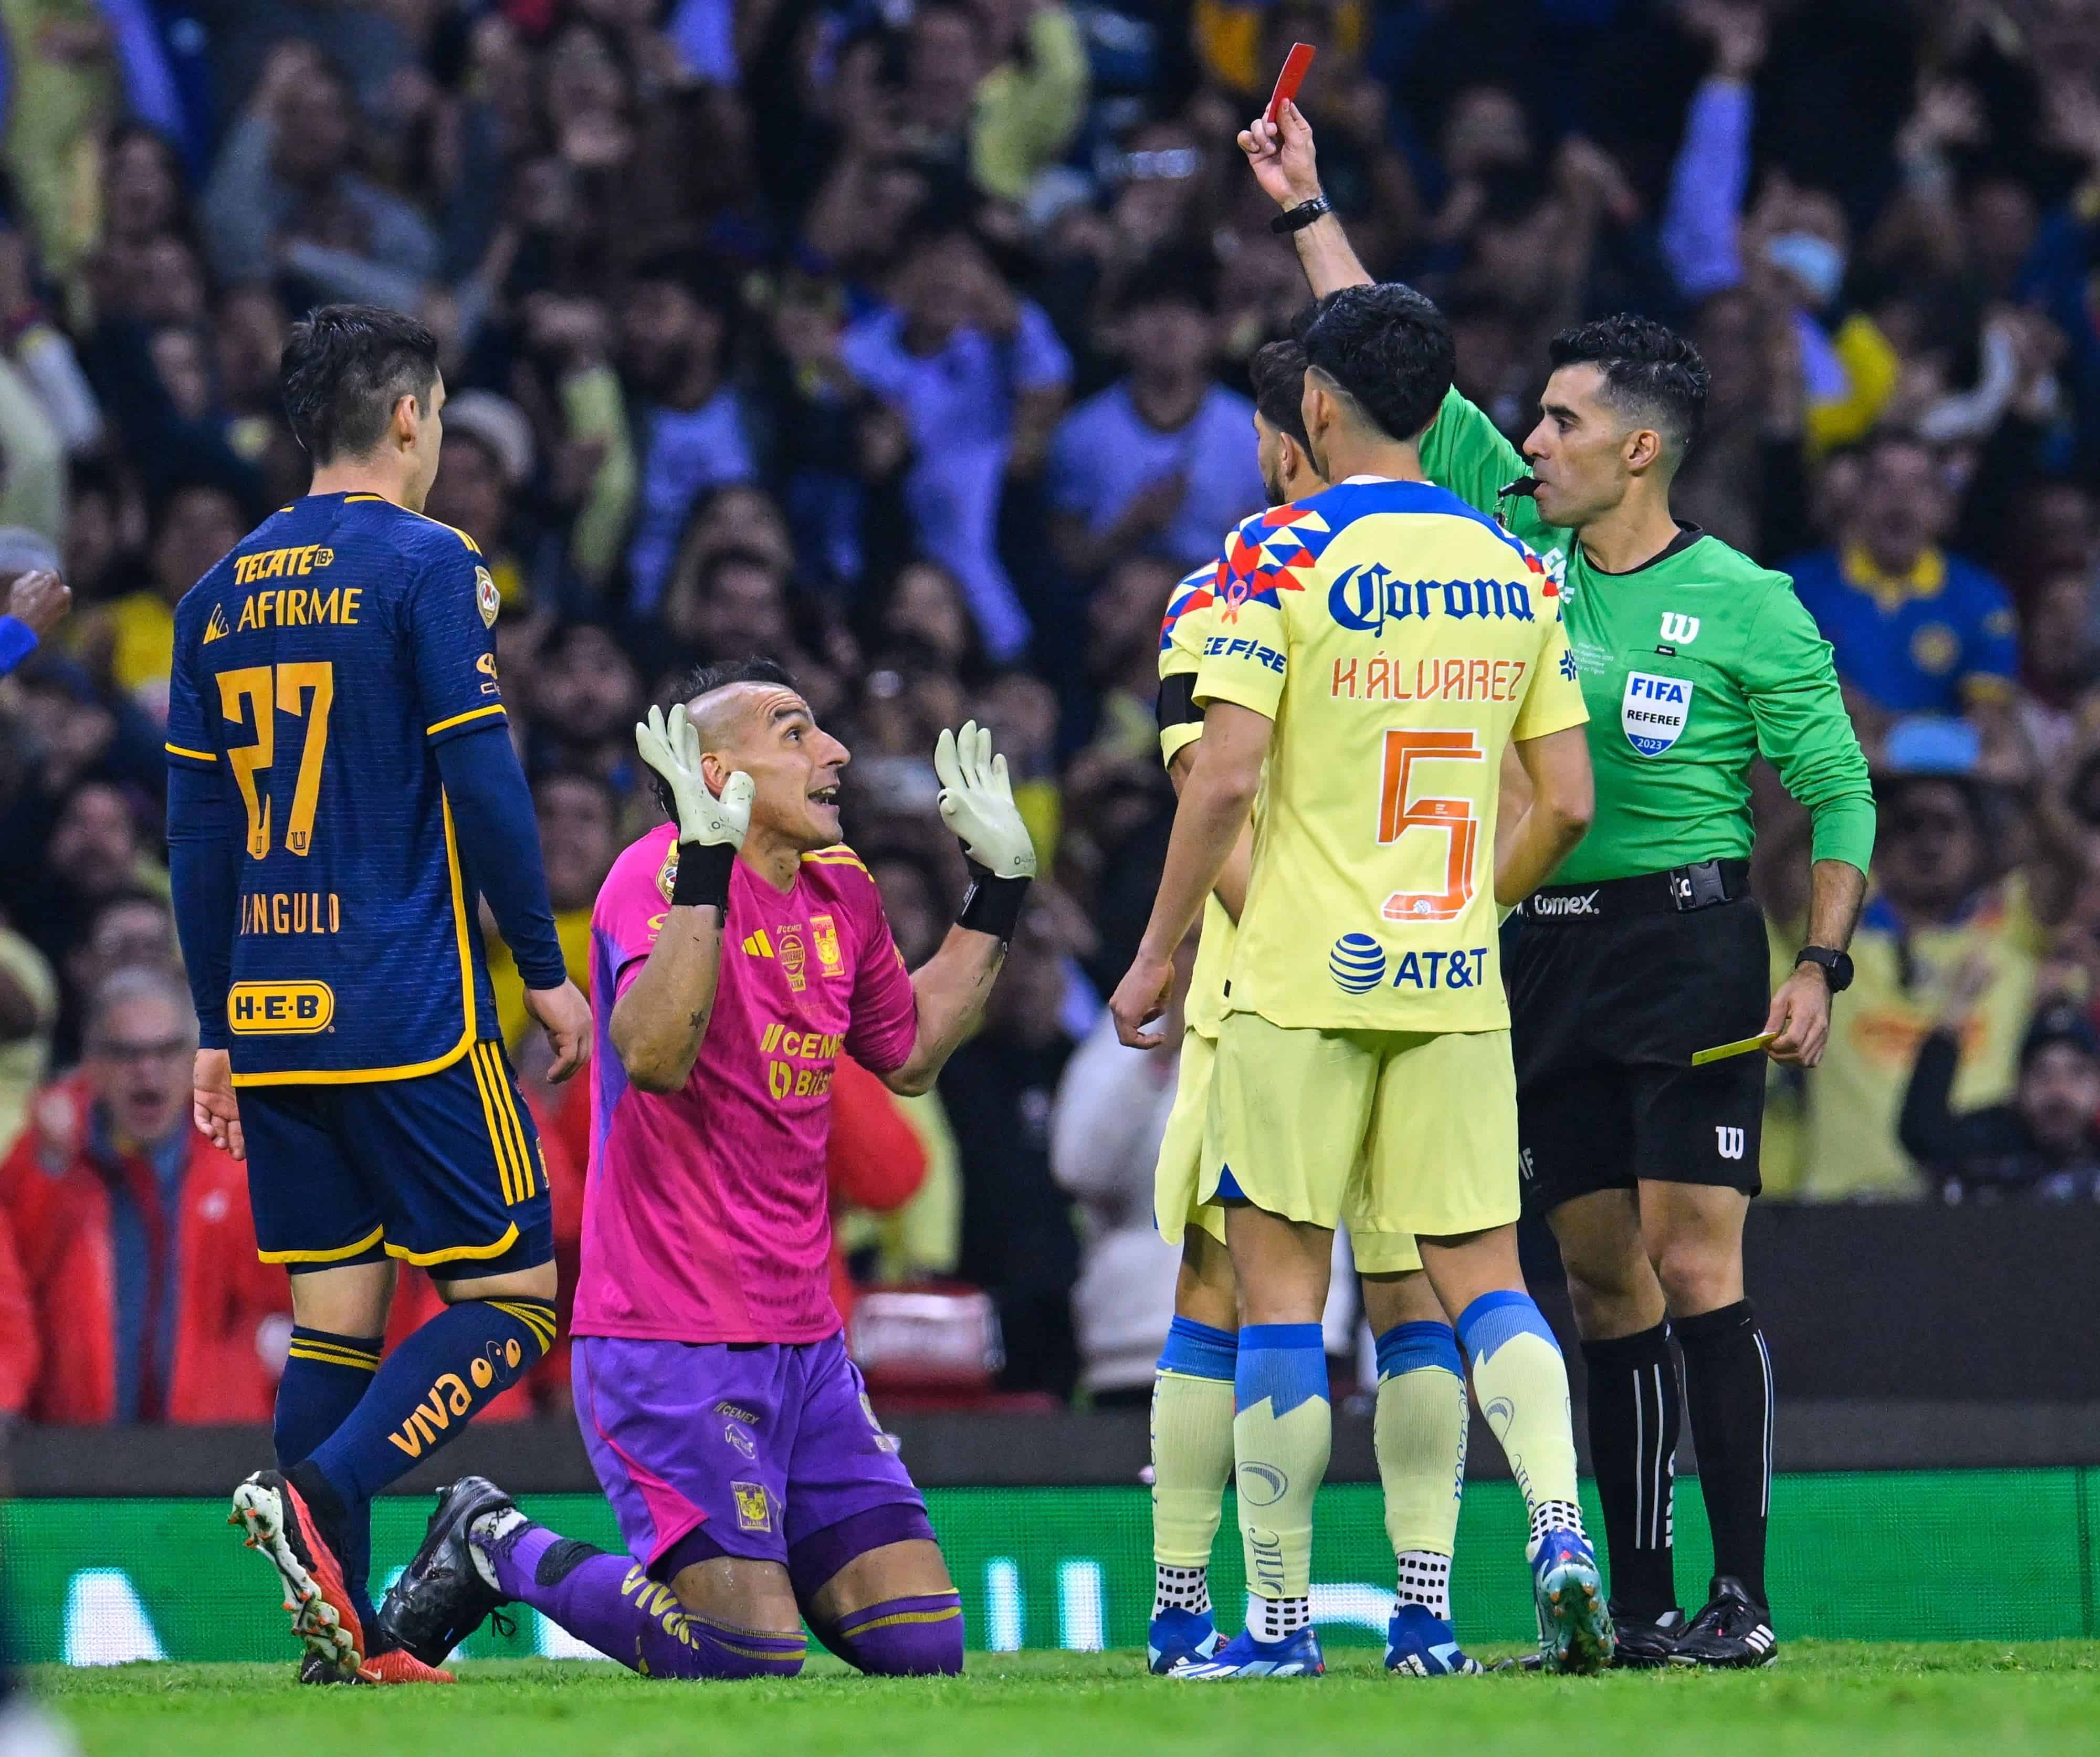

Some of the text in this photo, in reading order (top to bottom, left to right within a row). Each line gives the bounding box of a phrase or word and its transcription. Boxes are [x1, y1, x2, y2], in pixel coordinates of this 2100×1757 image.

[234, 544, 320, 585] TECATE
[237, 588, 363, 632] AFIRME
[1328, 562, 1534, 637] Corona
[1631, 677, 1684, 703] FIFA
[1627, 709, 1681, 726] REFEREE
[215, 661, 334, 860] 27
[1636, 737, 1662, 750] 2023
[1377, 728, 1486, 923] 5
[1393, 948, 1488, 988] AT&T
[722, 1404, 761, 1425] CEMEX
